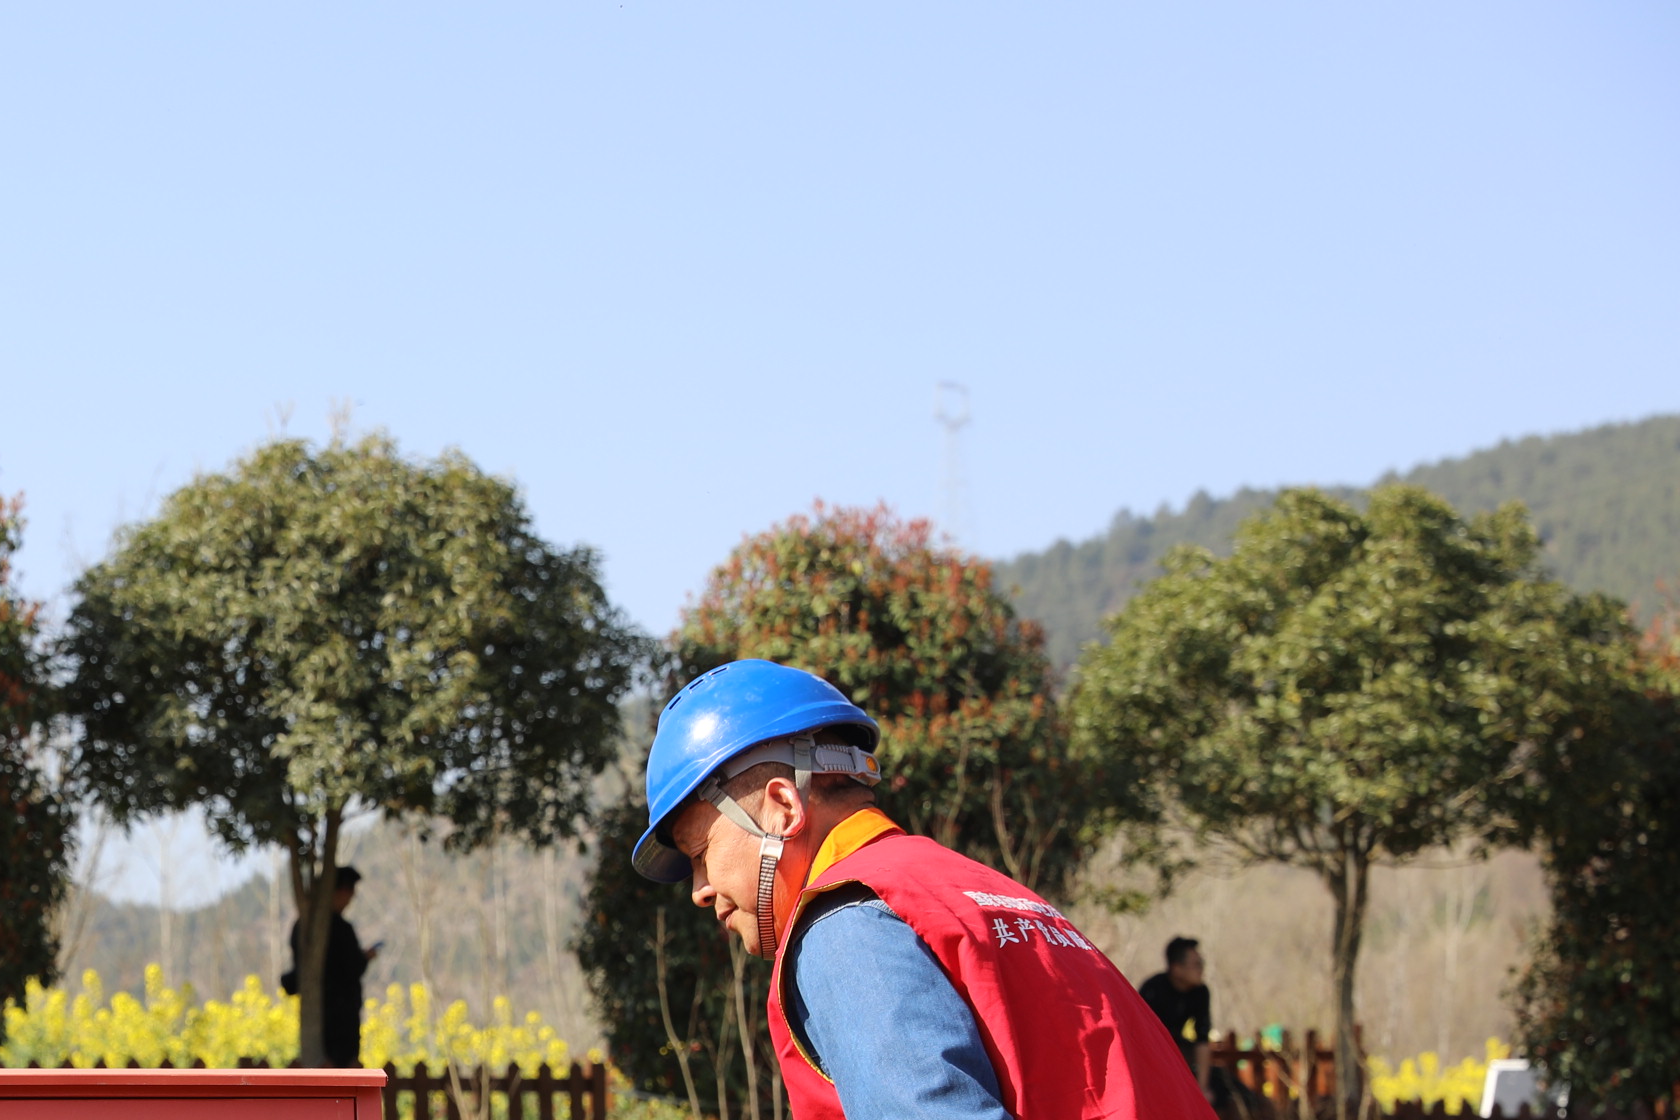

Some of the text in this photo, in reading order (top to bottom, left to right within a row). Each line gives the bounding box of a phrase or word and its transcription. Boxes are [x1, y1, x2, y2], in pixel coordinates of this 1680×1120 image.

[992, 917, 1099, 952] 共产党员服
